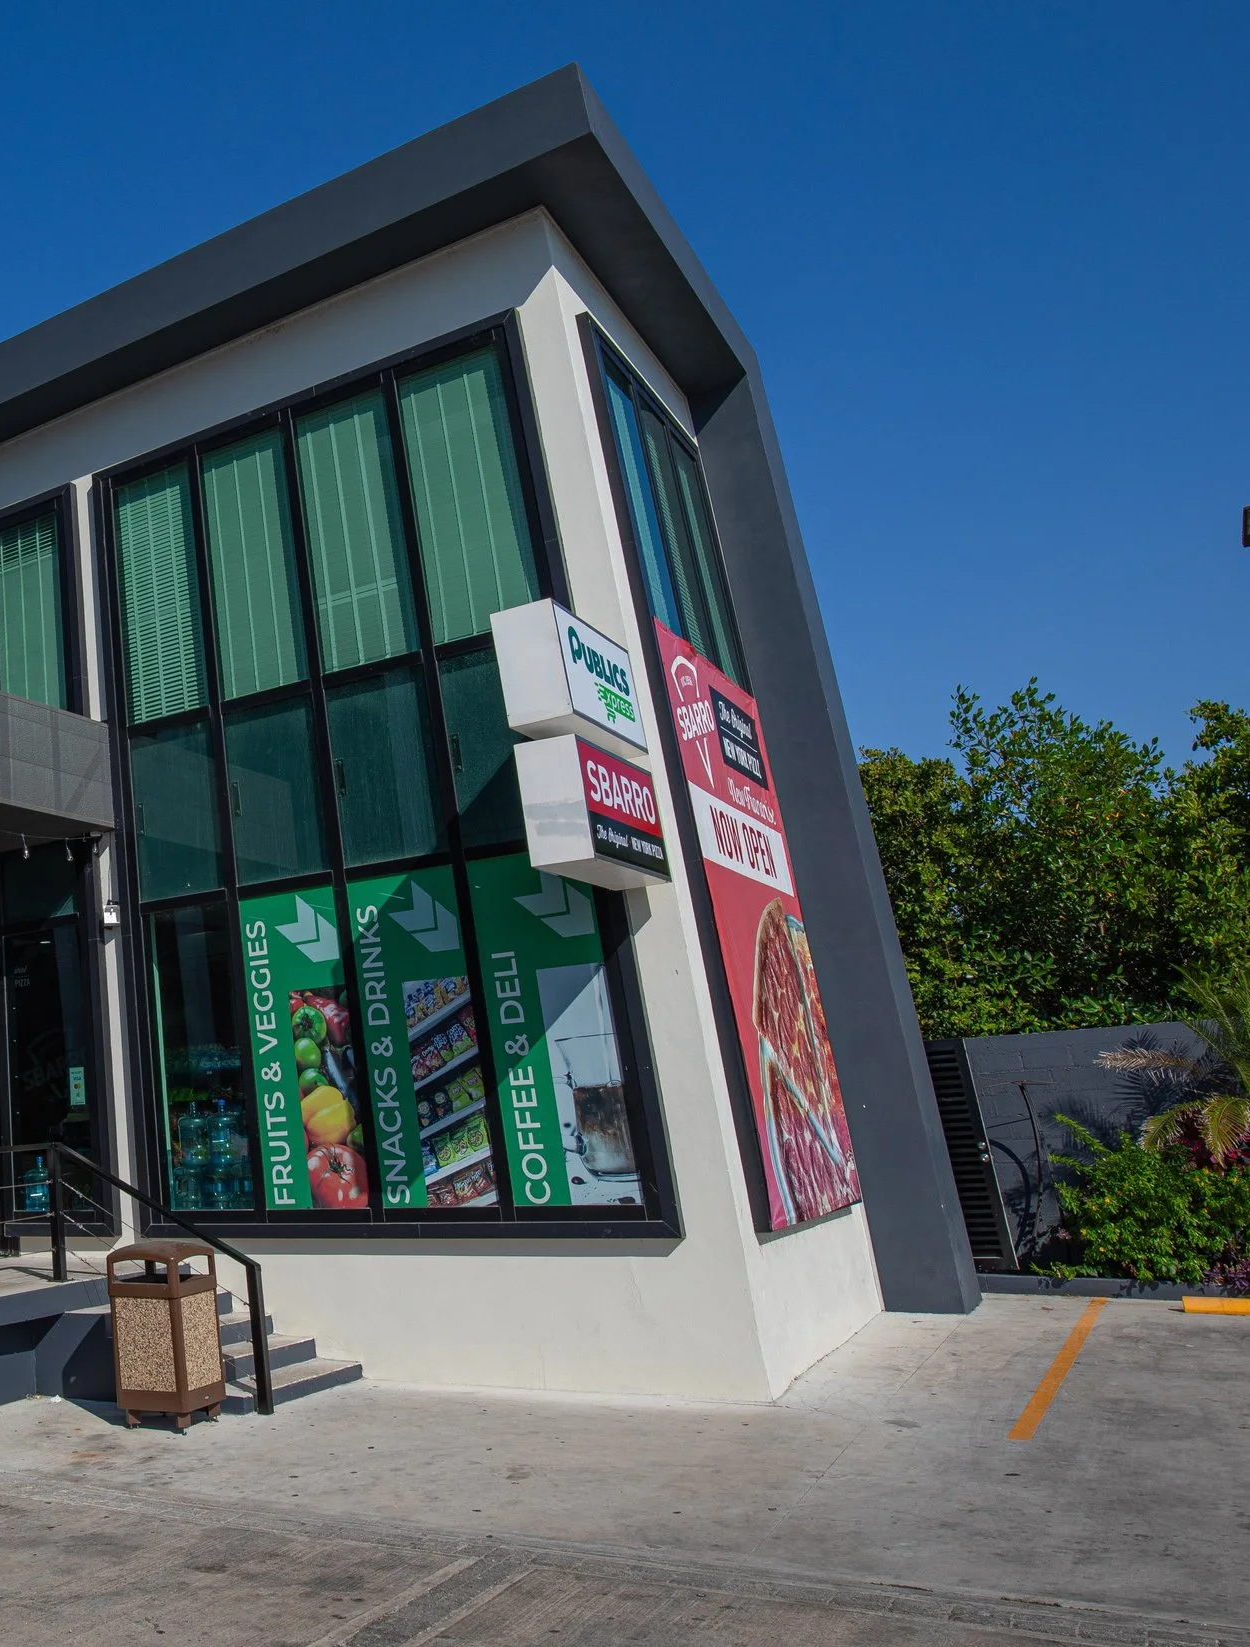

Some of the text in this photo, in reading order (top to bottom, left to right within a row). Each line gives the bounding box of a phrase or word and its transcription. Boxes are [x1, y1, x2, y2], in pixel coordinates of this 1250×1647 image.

[567, 625, 630, 697] PUBLICS
[676, 699, 715, 742] SBARRO
[718, 700, 753, 741] The Original
[722, 736, 737, 762] NEW
[735, 744, 750, 771] YORK
[586, 760, 656, 825] SBARRO
[596, 824, 665, 861] The Original NEW YORK PIZZA
[709, 804, 744, 865] NOW
[742, 822, 778, 879] OPEN
[245, 920, 296, 1205] FRUITS & VEGGIES
[356, 904, 411, 1204] SNACKS & DRINKS
[491, 950, 552, 1204] COFFEE & DELI
